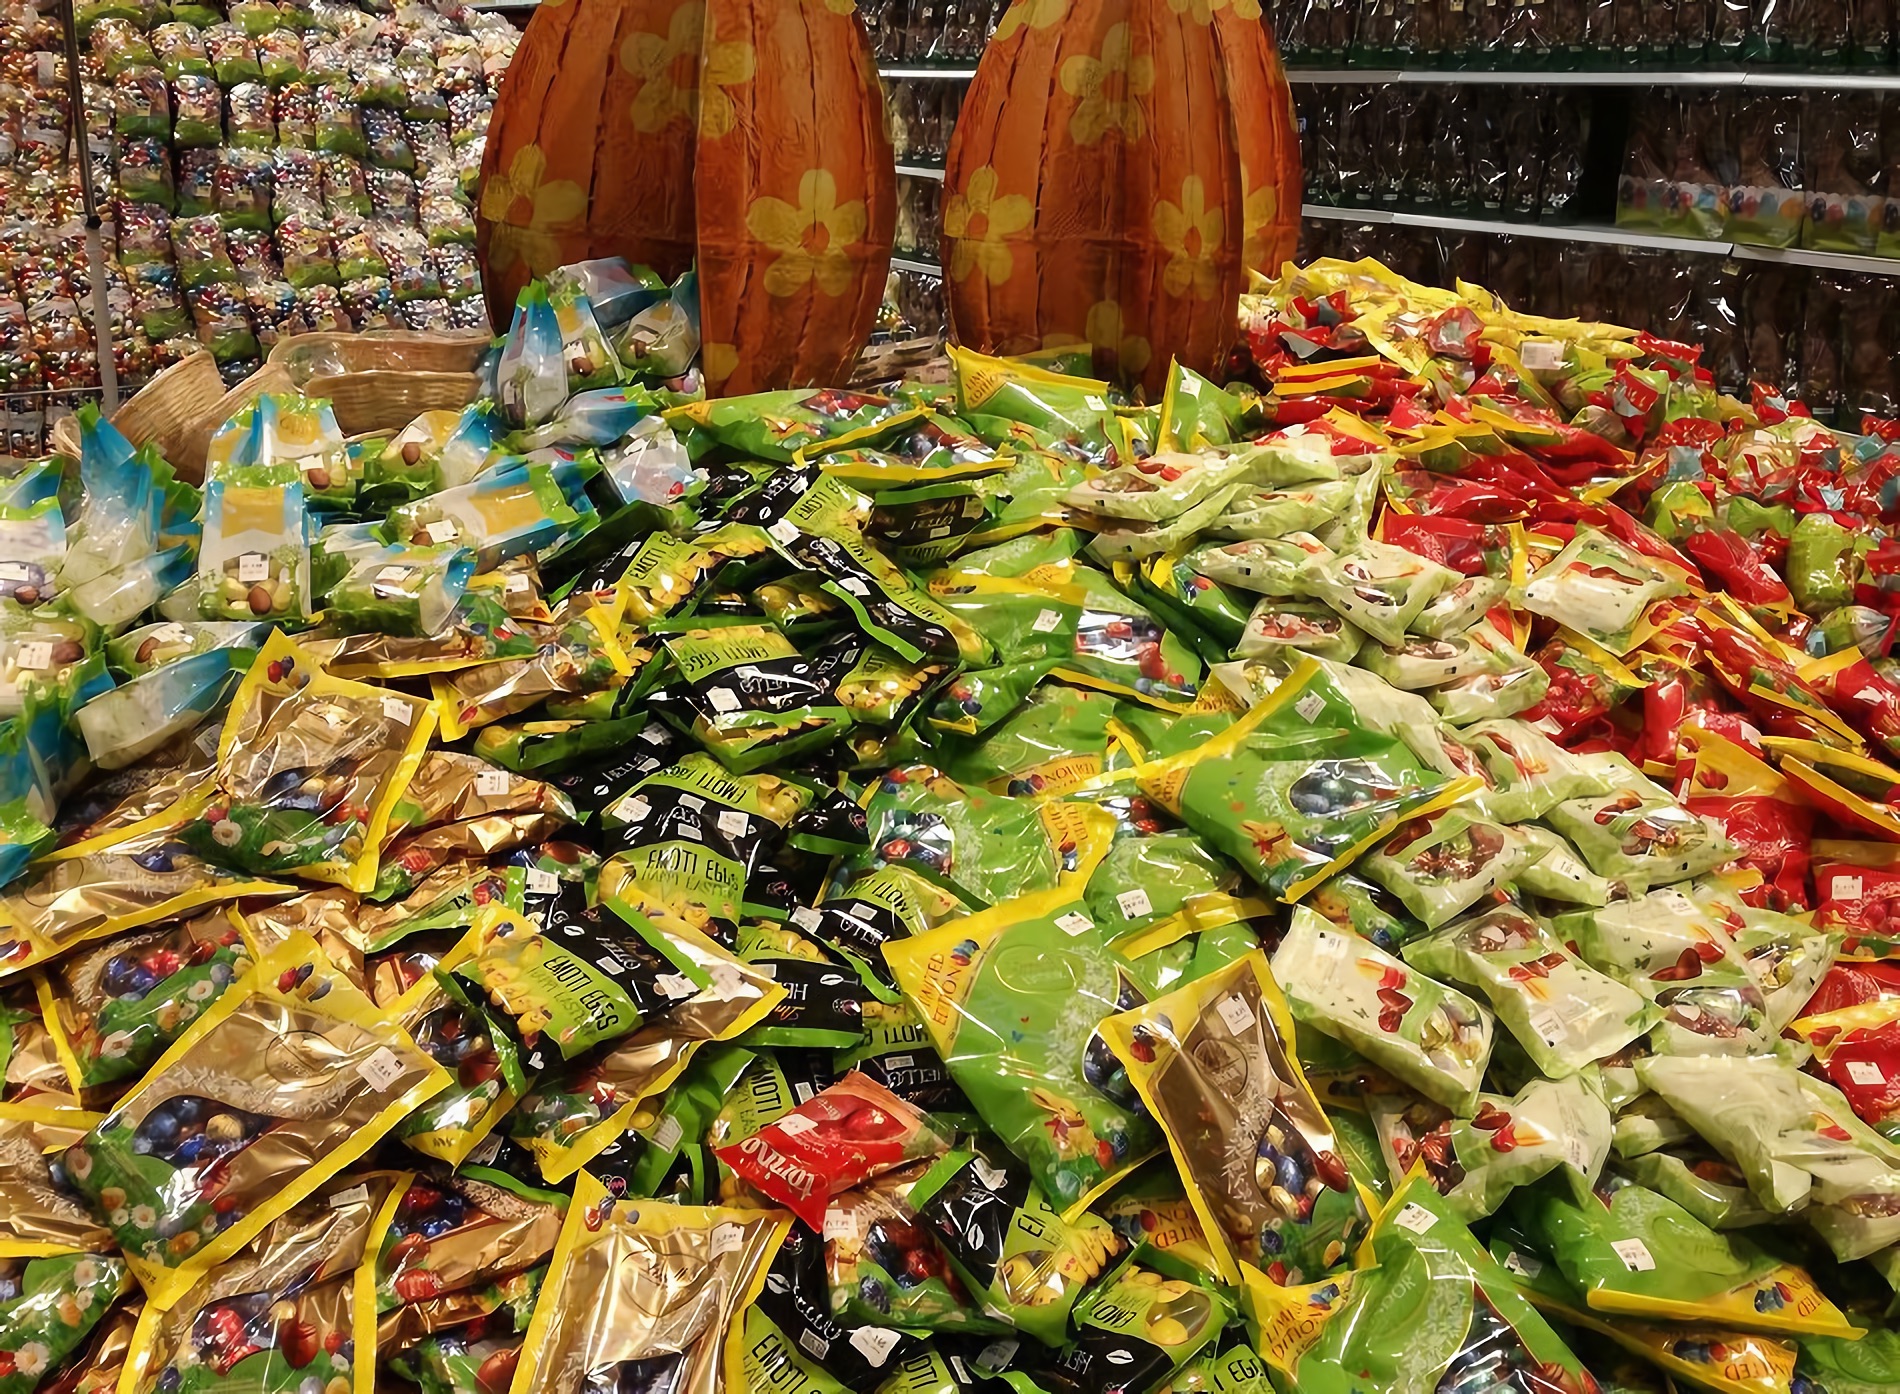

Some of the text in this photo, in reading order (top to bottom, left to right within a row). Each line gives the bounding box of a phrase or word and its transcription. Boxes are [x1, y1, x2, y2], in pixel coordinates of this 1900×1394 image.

[795, 486, 832, 521] EMOTI
[627, 546, 667, 580] EMOTI
[695, 772, 747, 804] EMOTI
[543, 955, 593, 993] EMOTI
[750, 1066, 782, 1114] MOTI
[752, 1333, 809, 1394] EMOTI
[902, 1354, 939, 1391] OTI
